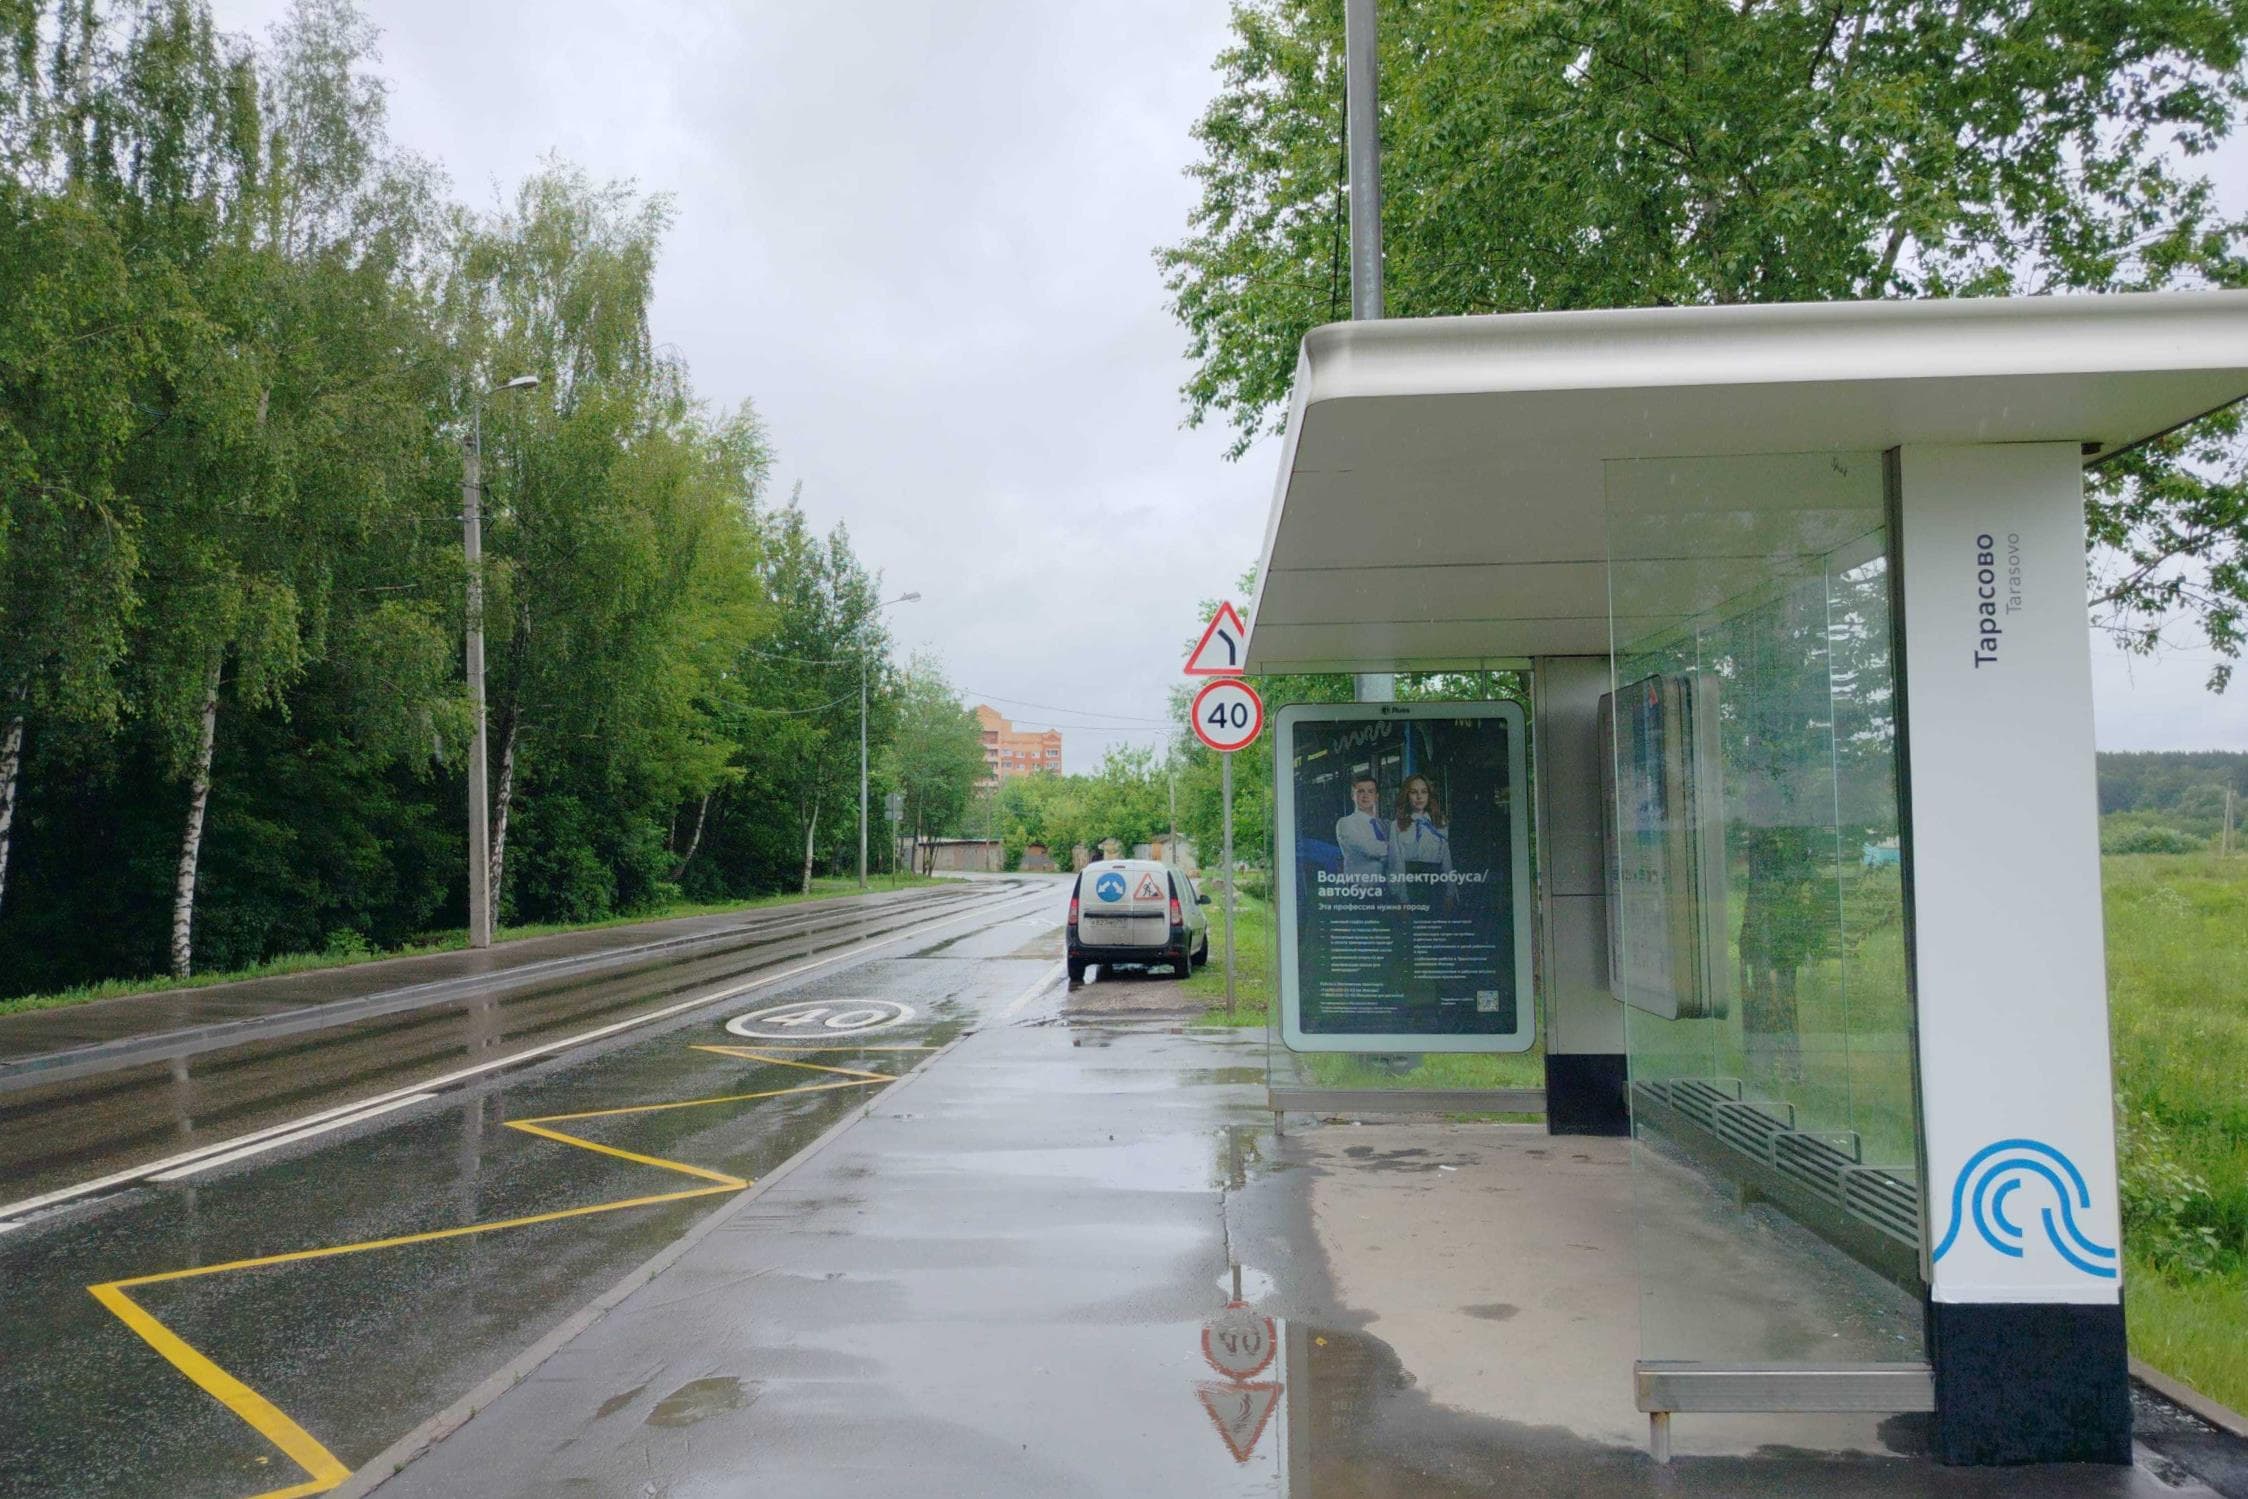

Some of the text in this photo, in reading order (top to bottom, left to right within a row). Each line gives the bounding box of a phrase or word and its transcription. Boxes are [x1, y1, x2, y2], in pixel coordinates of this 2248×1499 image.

[2005, 533, 2022, 615] Tarasovo
[1974, 534, 2003, 669] Тарасово
[1207, 702, 1248, 729] 40
[1317, 869, 1489, 886] Водитель электробуса/
[1318, 885, 1383, 899] автобуса
[1333, 903, 1376, 912] профессия
[1403, 903, 1431, 912] городу
[761, 1008, 887, 1028] 40
